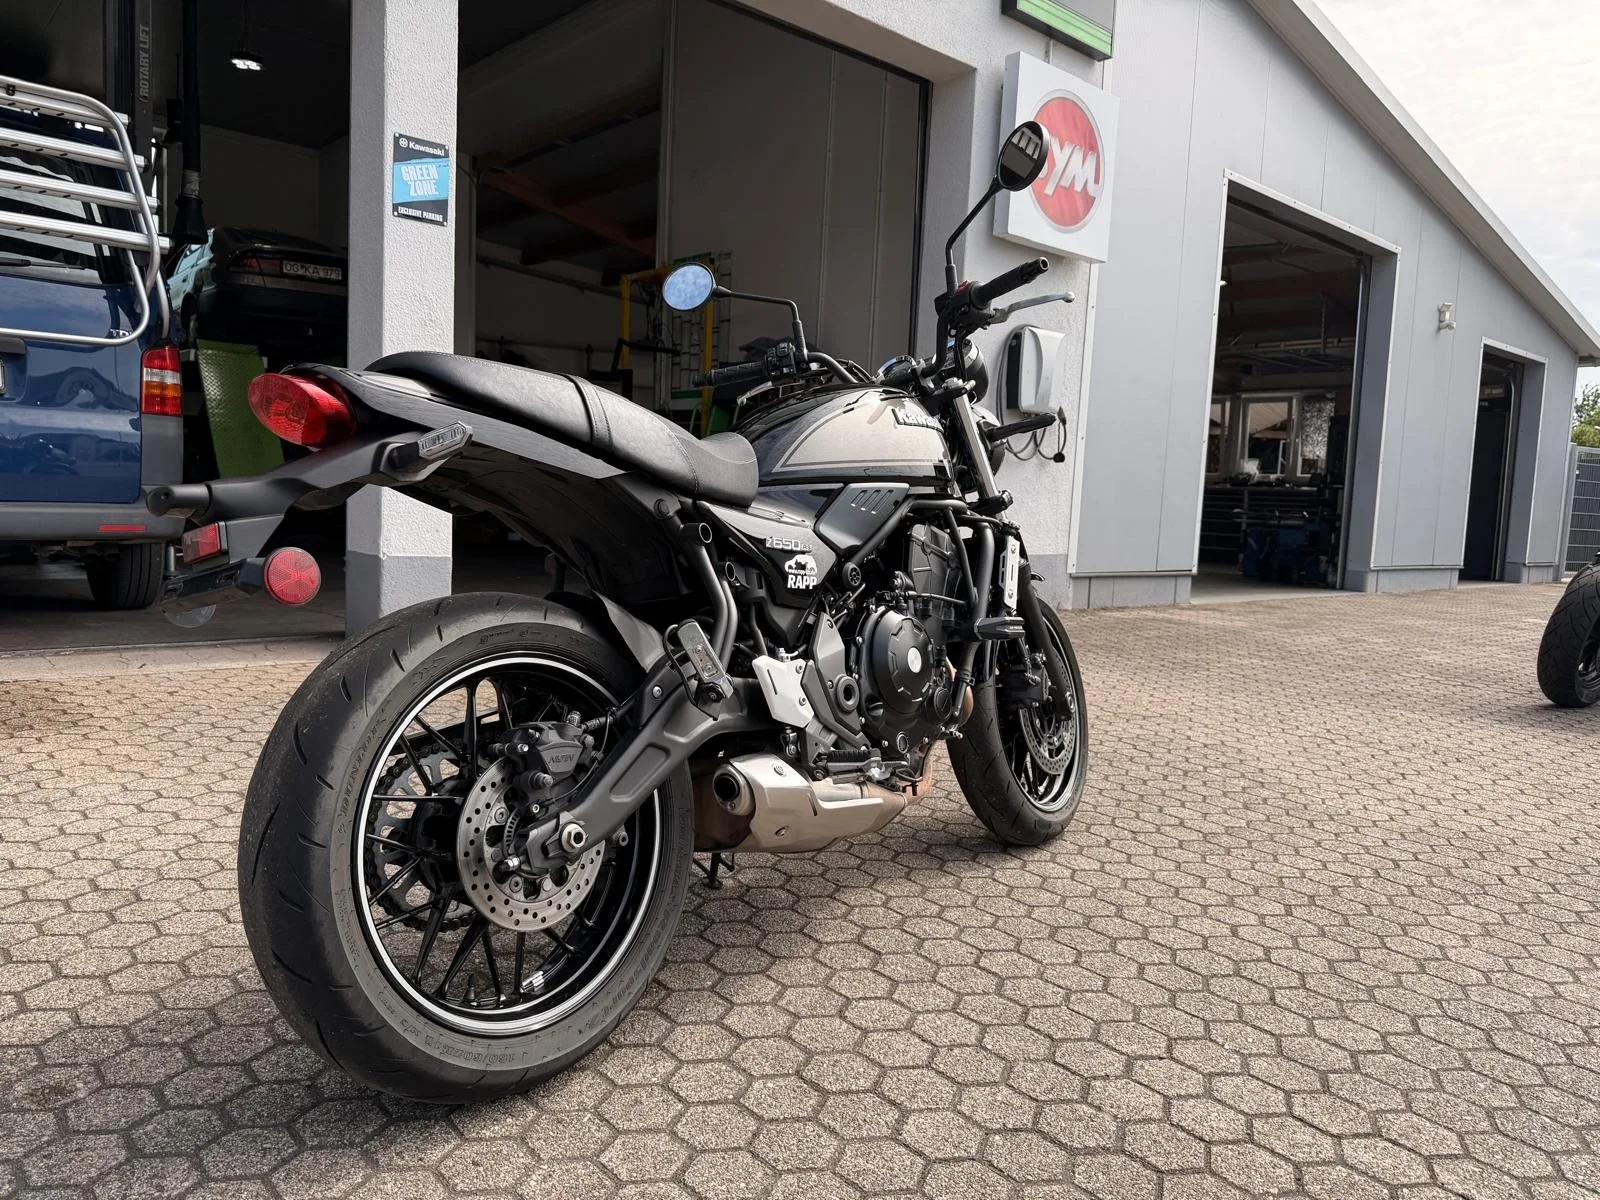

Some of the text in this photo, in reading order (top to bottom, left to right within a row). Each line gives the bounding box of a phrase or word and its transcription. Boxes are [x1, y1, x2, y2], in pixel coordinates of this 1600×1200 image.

[139, 24, 149, 97] ROTARY LIFT
[409, 141, 445, 157] Kawasaki
[401, 165, 438, 181] GREEN
[1037, 135, 1100, 199] YM
[408, 179, 439, 196] ZONE
[398, 206, 443, 222] EXCLUSIVE PARKING
[787, 575, 817, 590] RAPP
